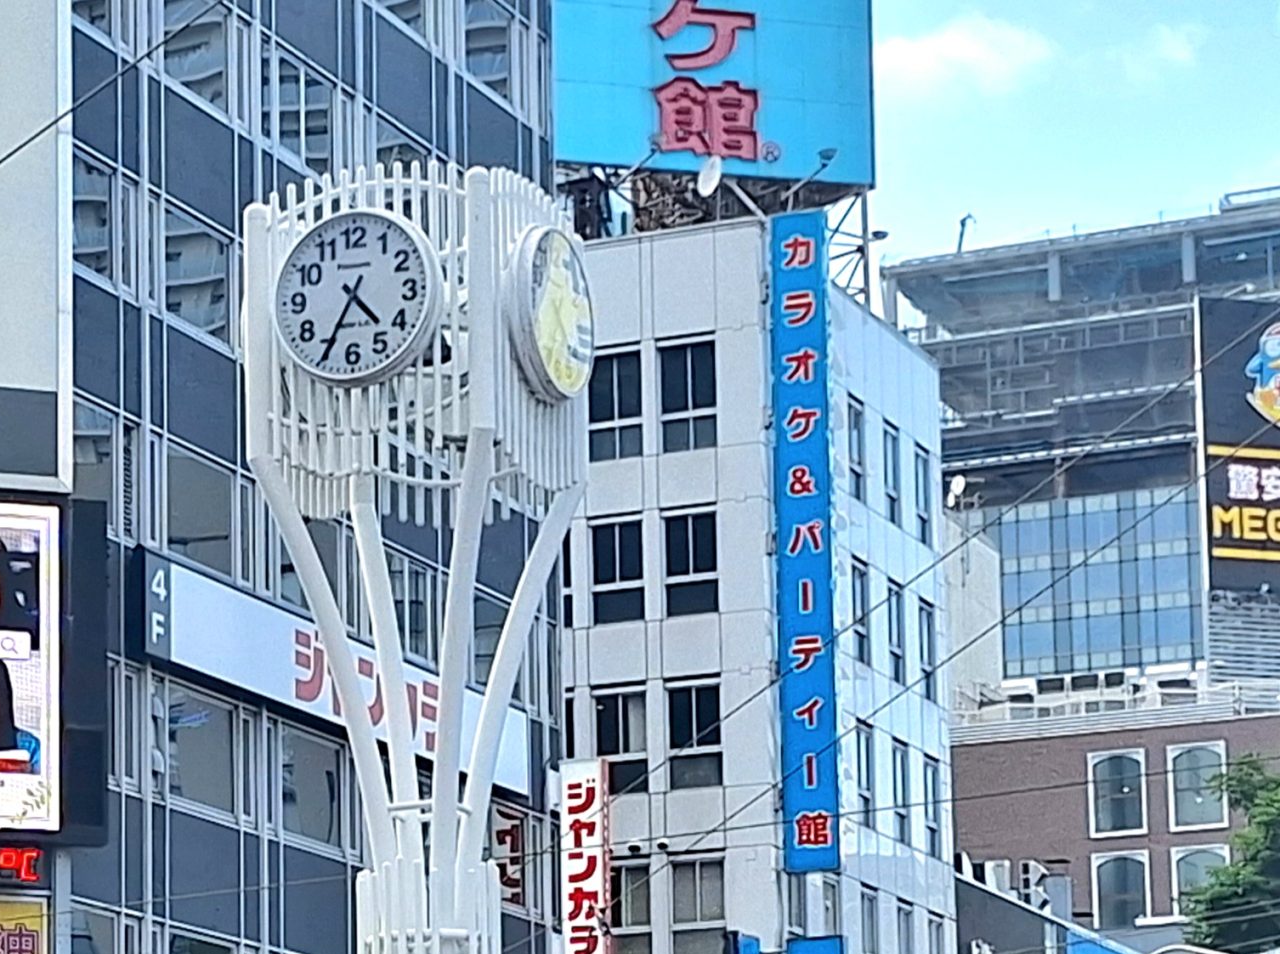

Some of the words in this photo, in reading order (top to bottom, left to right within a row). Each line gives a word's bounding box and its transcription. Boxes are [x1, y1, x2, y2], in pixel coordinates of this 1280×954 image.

[341, 227, 367, 249] 12
[378, 233, 389, 254] 1
[316, 239, 337, 262] 11
[394, 250, 410, 272] 2
[296, 263, 322, 285] 10
[402, 279, 418, 301] 3
[291, 292, 306, 314] 9
[299, 320, 315, 342] 8
[391, 308, 408, 332] 4
[372, 331, 388, 354] 5
[344, 343, 361, 365] 6
